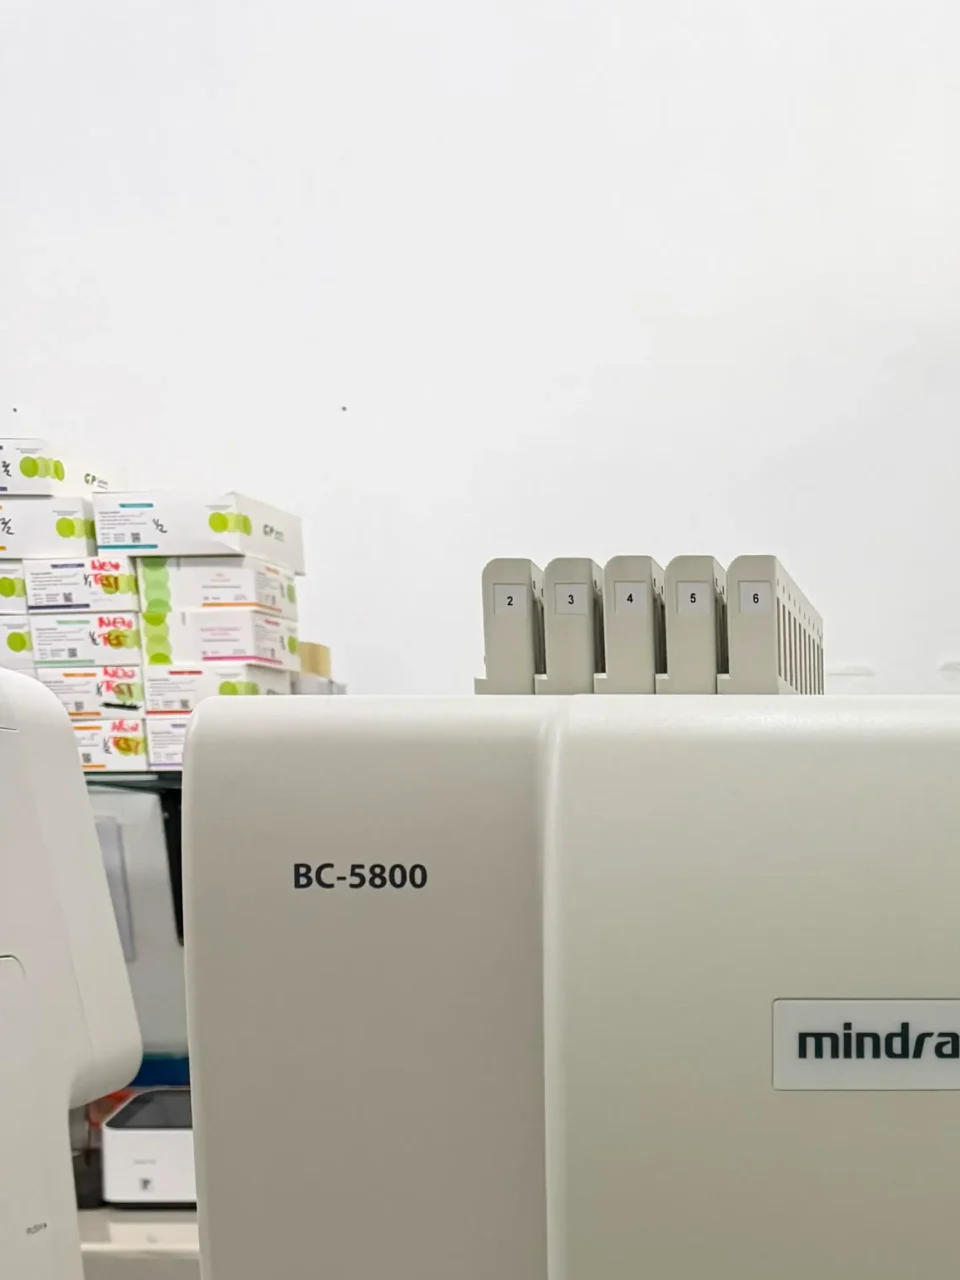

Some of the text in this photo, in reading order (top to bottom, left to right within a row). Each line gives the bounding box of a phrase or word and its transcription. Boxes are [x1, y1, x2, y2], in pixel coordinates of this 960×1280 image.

[507, 596, 513, 606] 2
[568, 594, 574, 604] 3
[627, 593, 633, 603] 4
[690, 593, 697, 603] 5
[753, 593, 760, 603] 6
[294, 863, 427, 889] BC-5800
